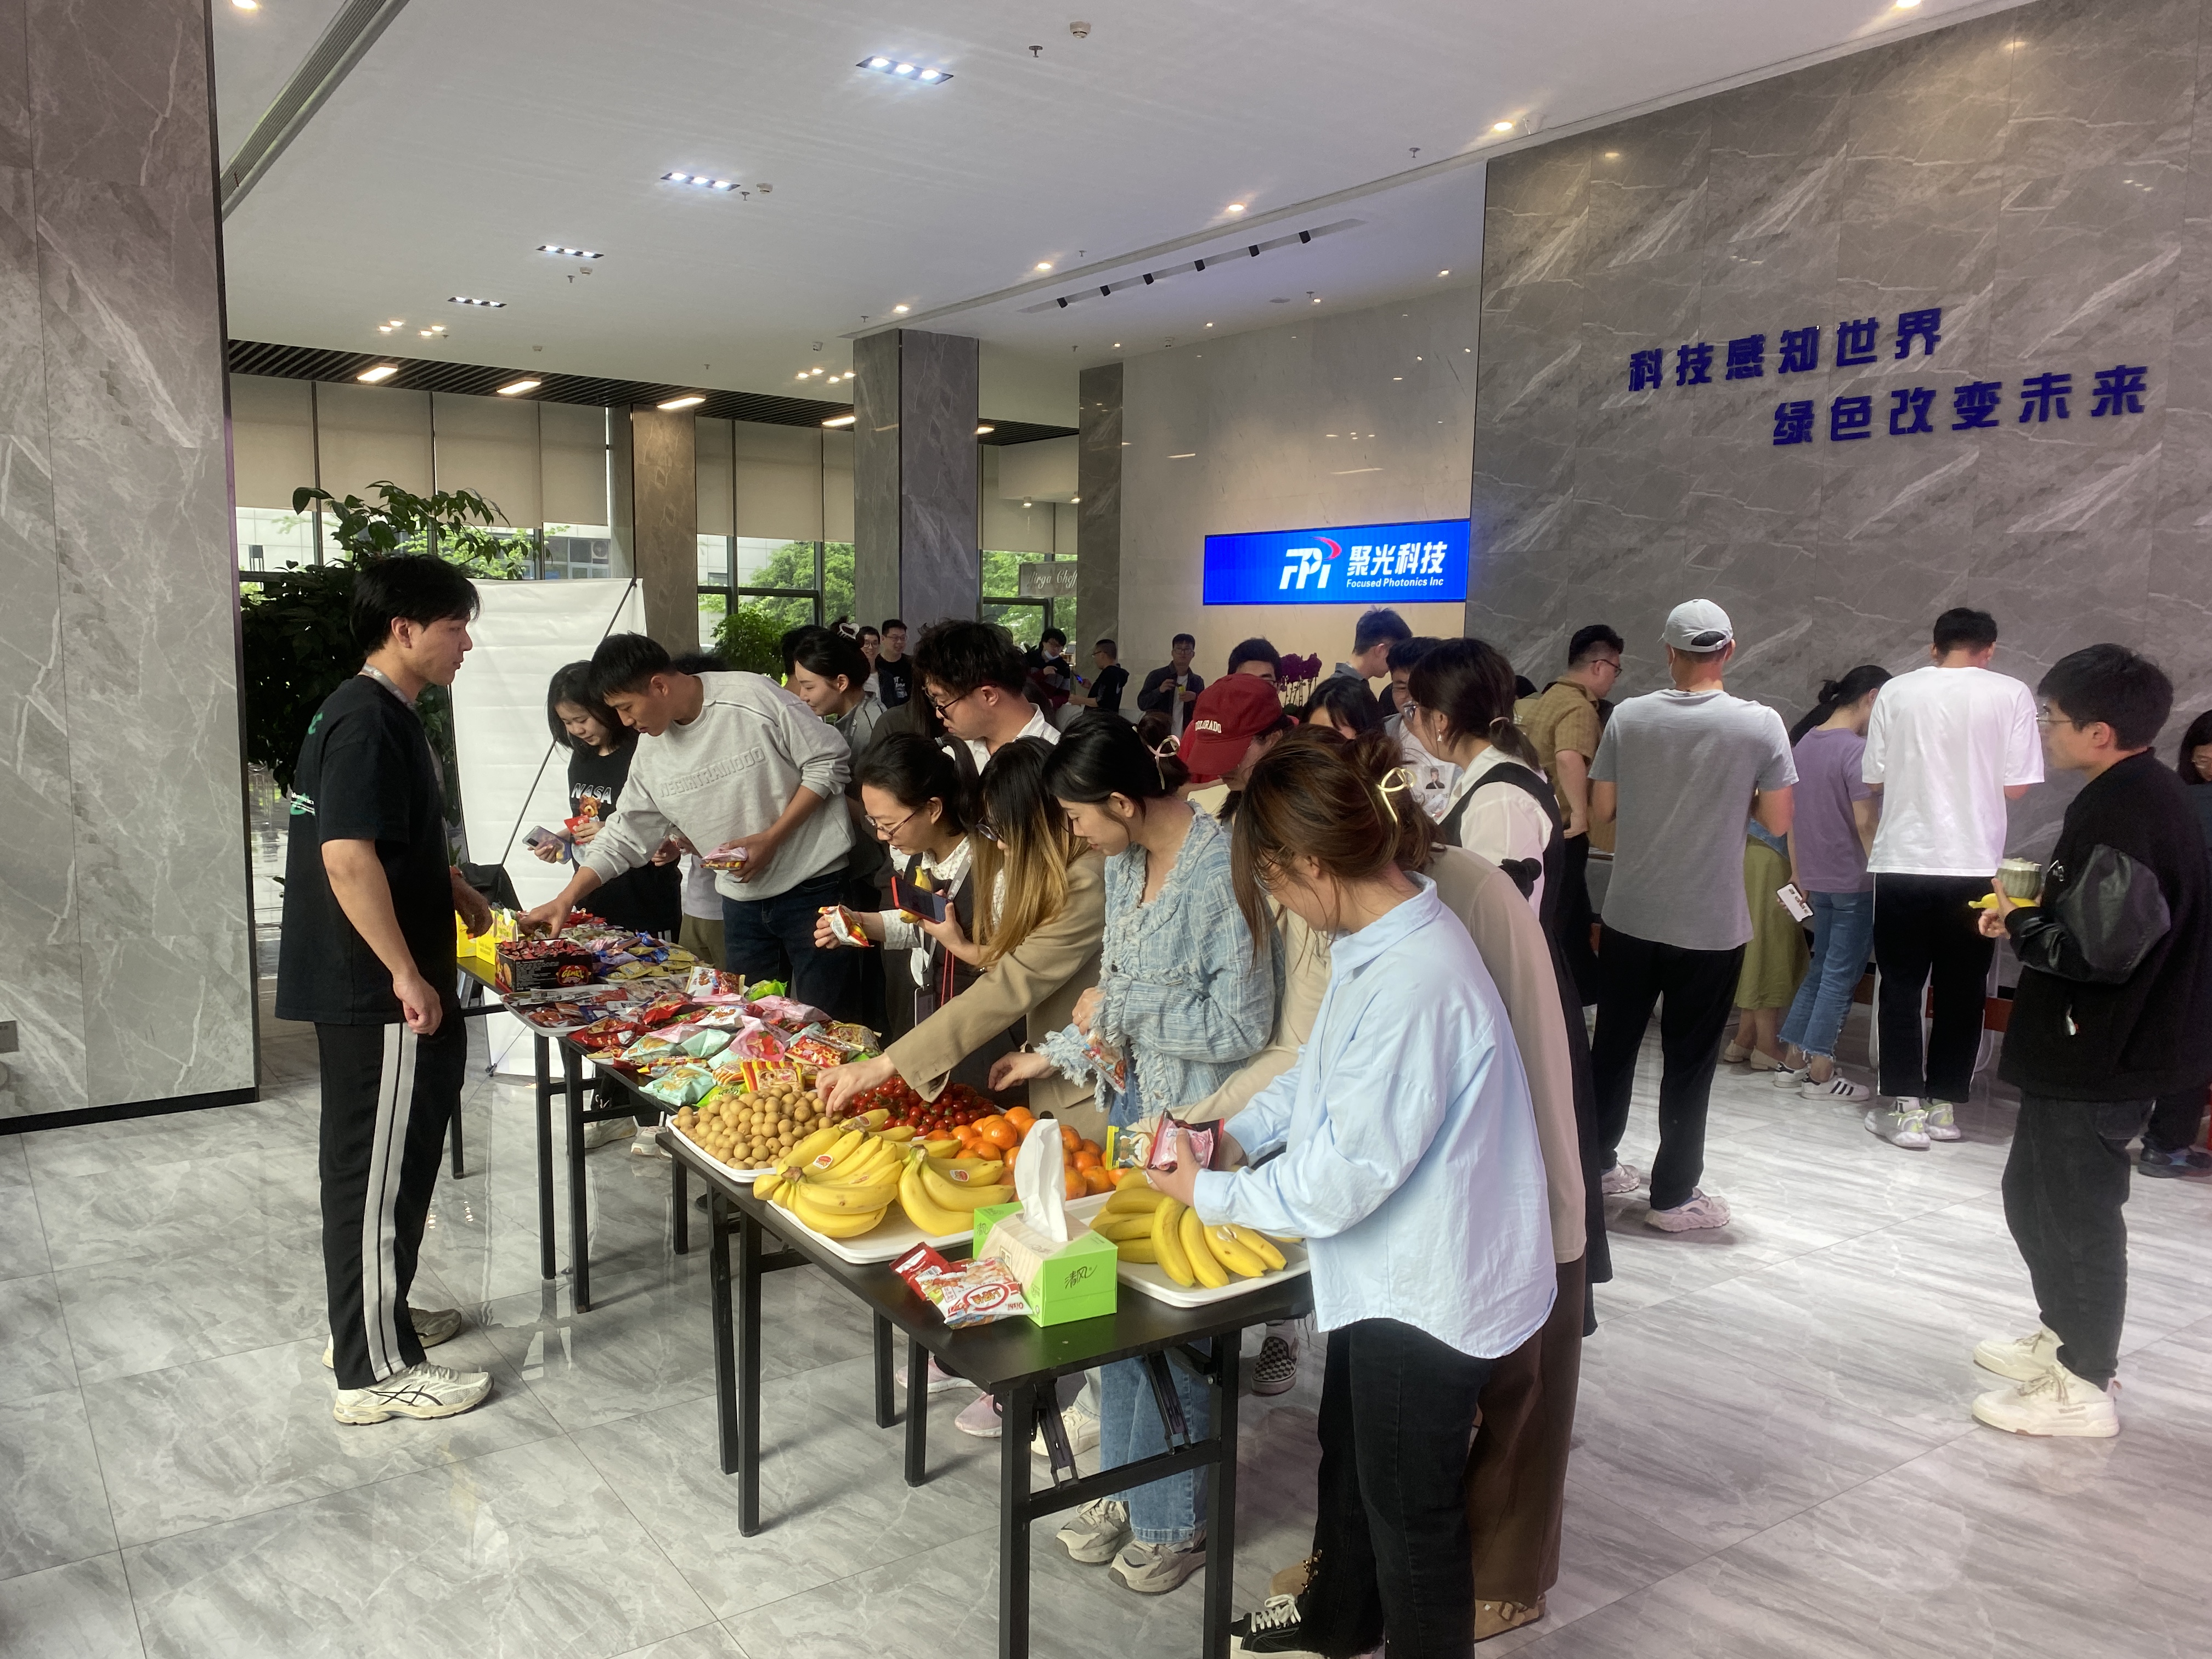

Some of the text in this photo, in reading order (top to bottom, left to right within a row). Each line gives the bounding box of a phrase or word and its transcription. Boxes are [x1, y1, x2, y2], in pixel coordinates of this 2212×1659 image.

[1628, 307, 1943, 391] 科技感知世界
[1773, 364, 2148, 445] 绿色改变未来
[1346, 541, 1447, 576] 聚光科技
[1346, 577, 1444, 588] Focused Photonics Inc
[571, 783, 612, 805] NASA
[1064, 1264, 1097, 1289] 清风
[1007, 1302, 1024, 1311] Oishi
